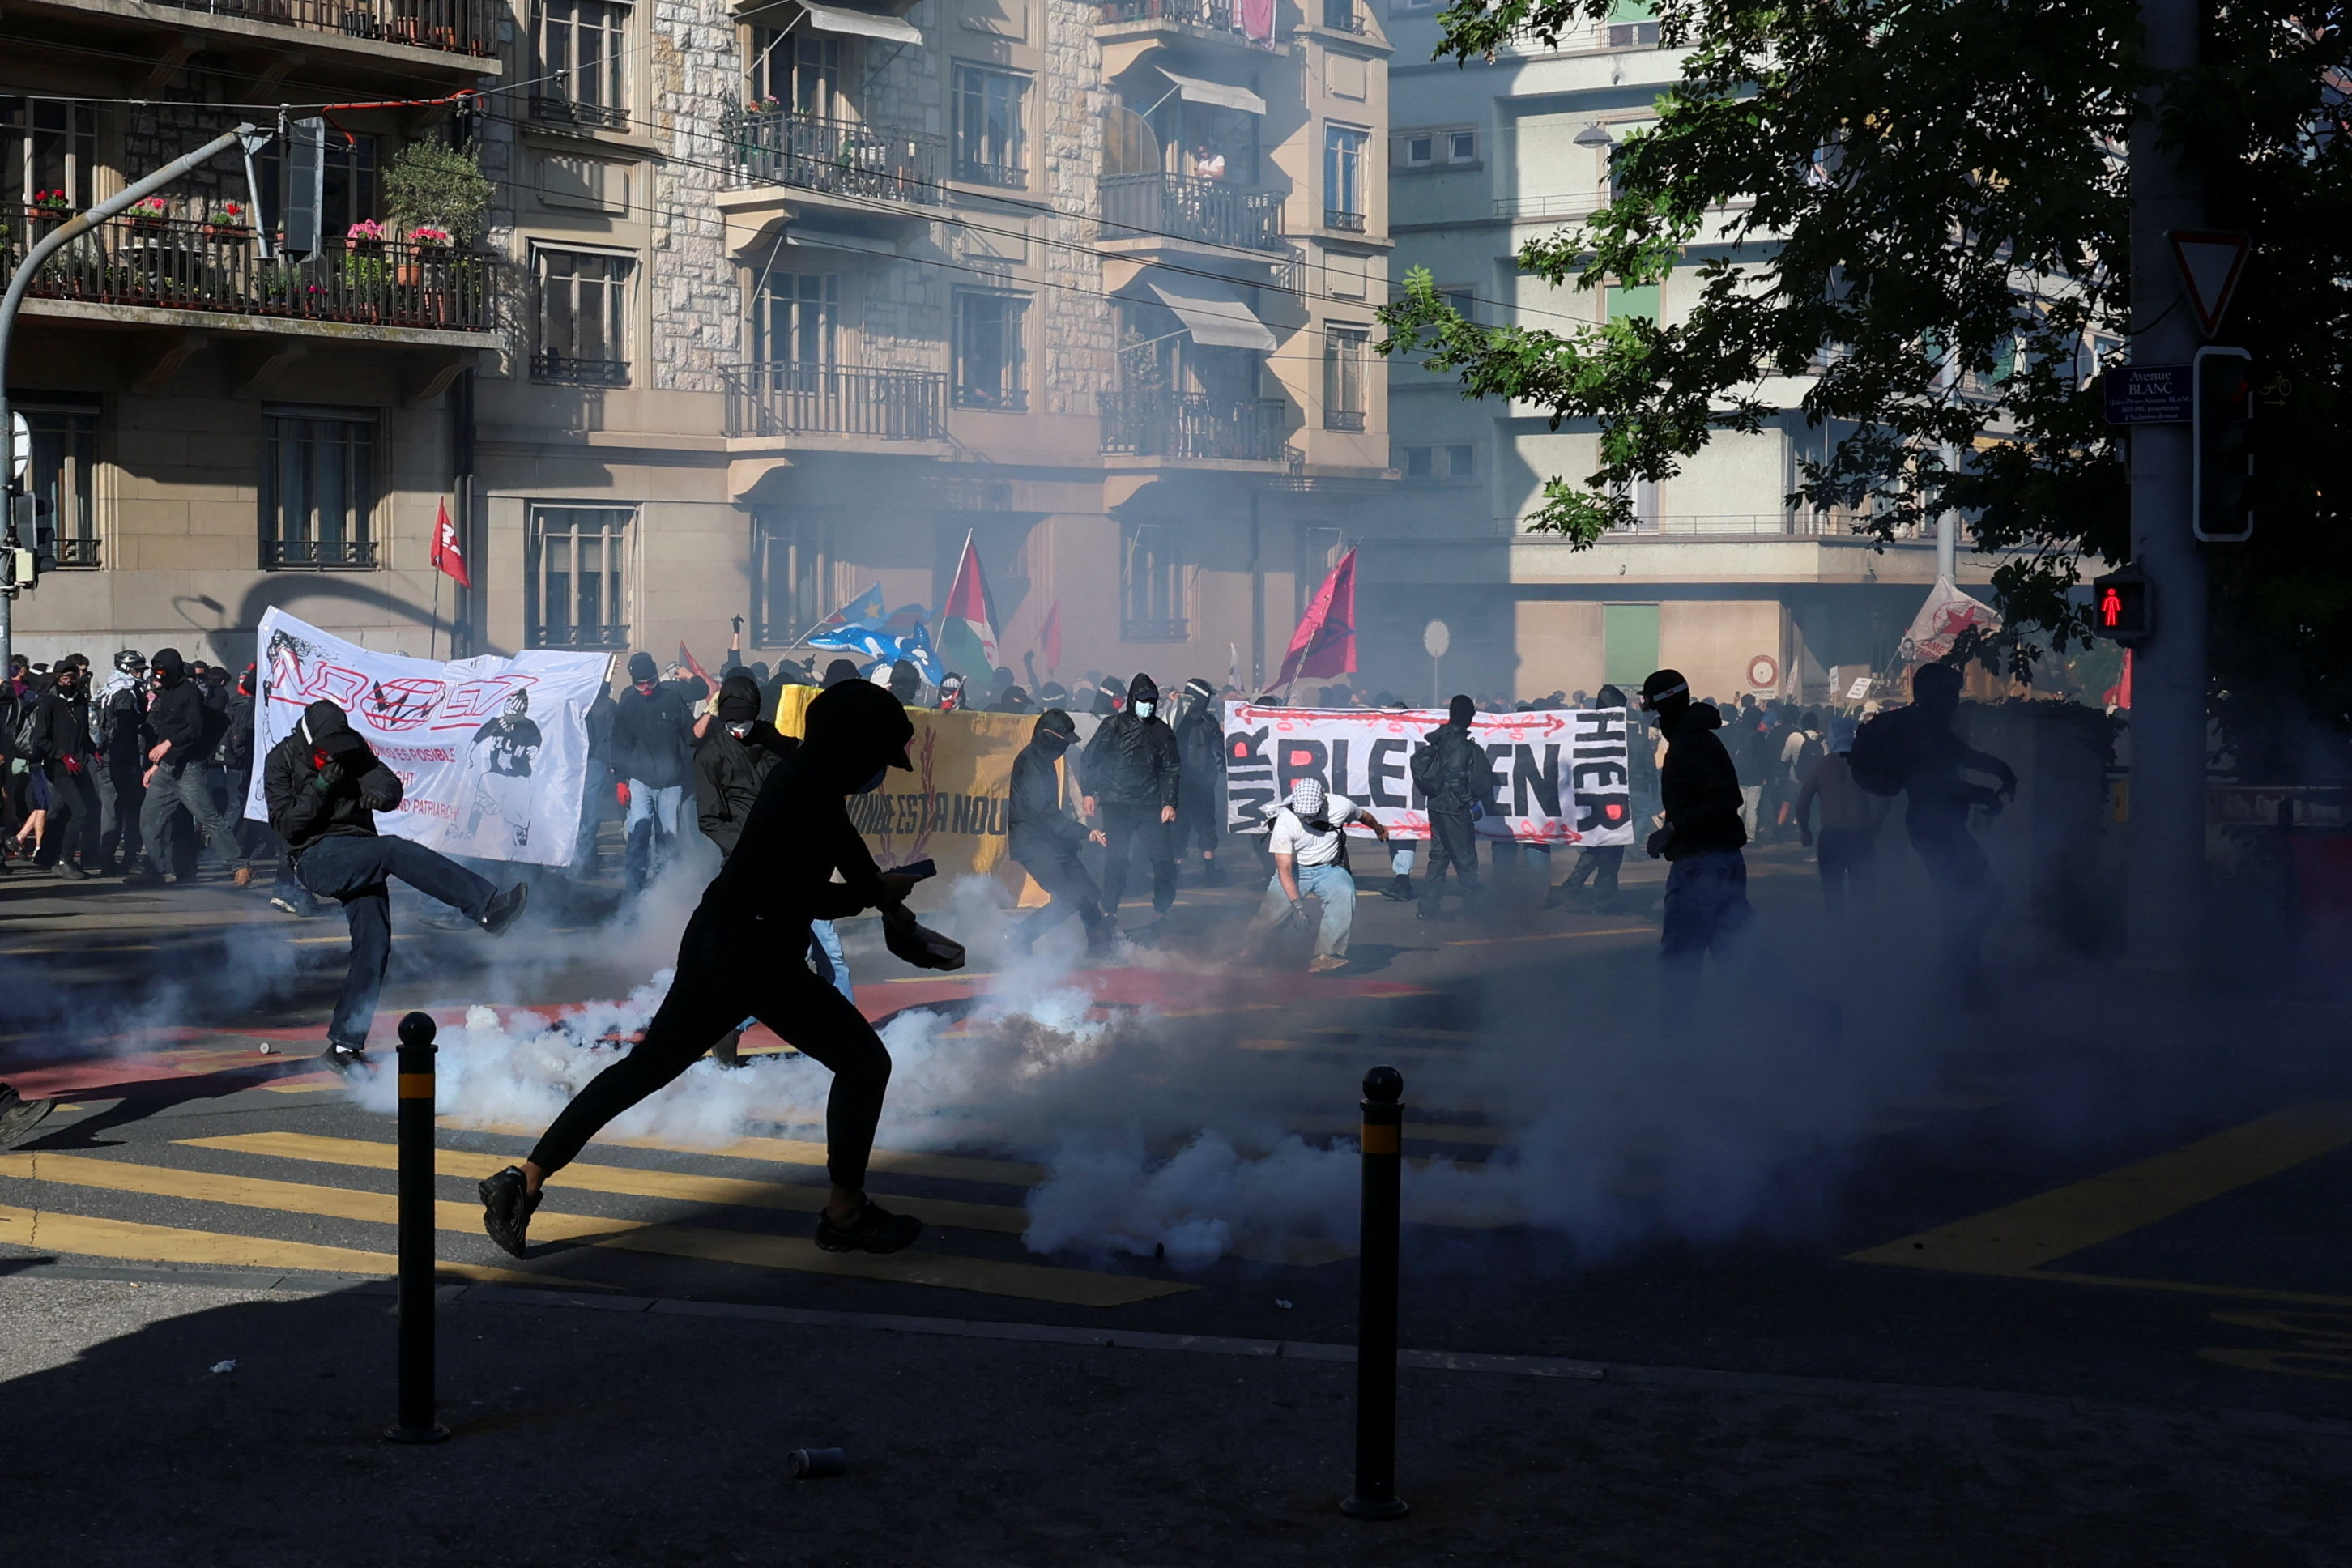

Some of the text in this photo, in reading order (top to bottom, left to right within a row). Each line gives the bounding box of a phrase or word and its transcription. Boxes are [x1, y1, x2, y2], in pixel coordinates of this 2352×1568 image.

[2129, 371, 2171, 381] Avenue
[2129, 382, 2172, 395] BLANC
[271, 646, 369, 712] NO
[409, 748, 456, 763] POSIBLE
[1226, 712, 1631, 833] WIR BLEIEN HIER
